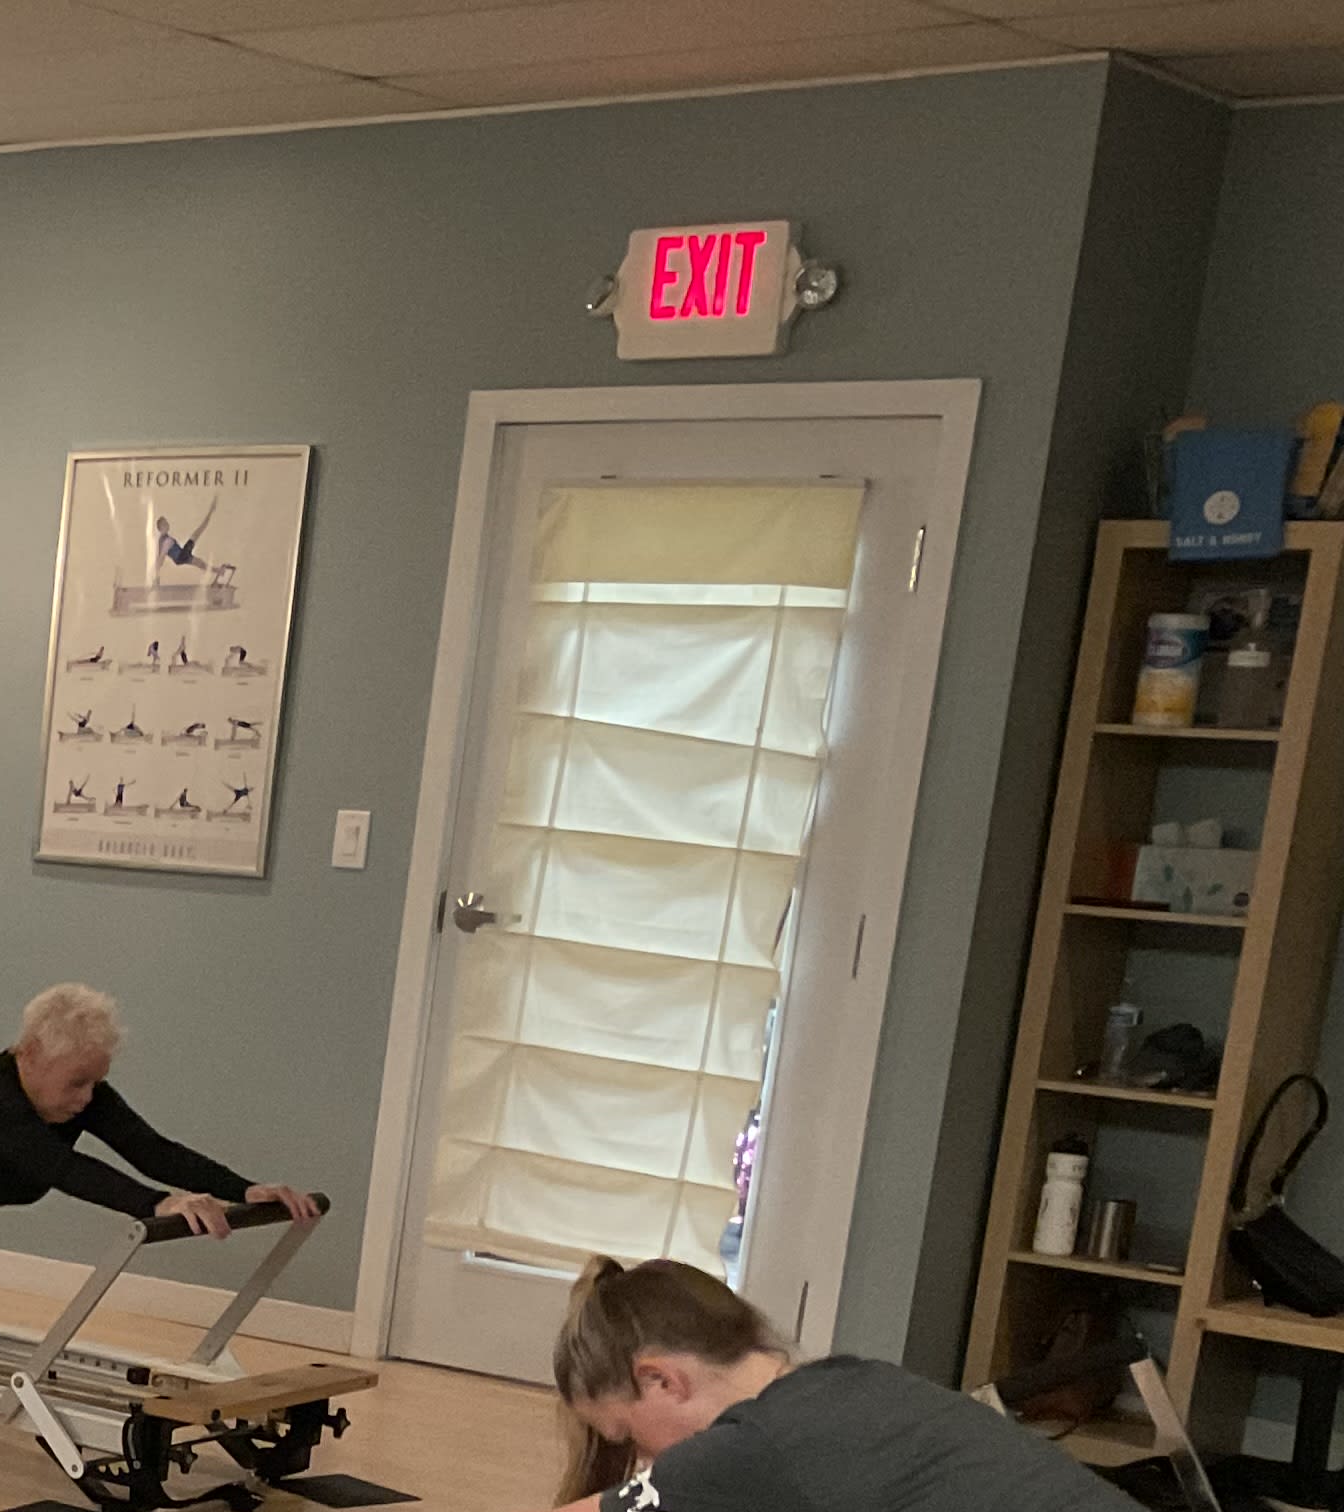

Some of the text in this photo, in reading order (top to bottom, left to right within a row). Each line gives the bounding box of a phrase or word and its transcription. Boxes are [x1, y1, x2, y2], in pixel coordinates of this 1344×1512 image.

[650, 231, 766, 320] EXIT
[123, 469, 249, 488] REFORMER II
